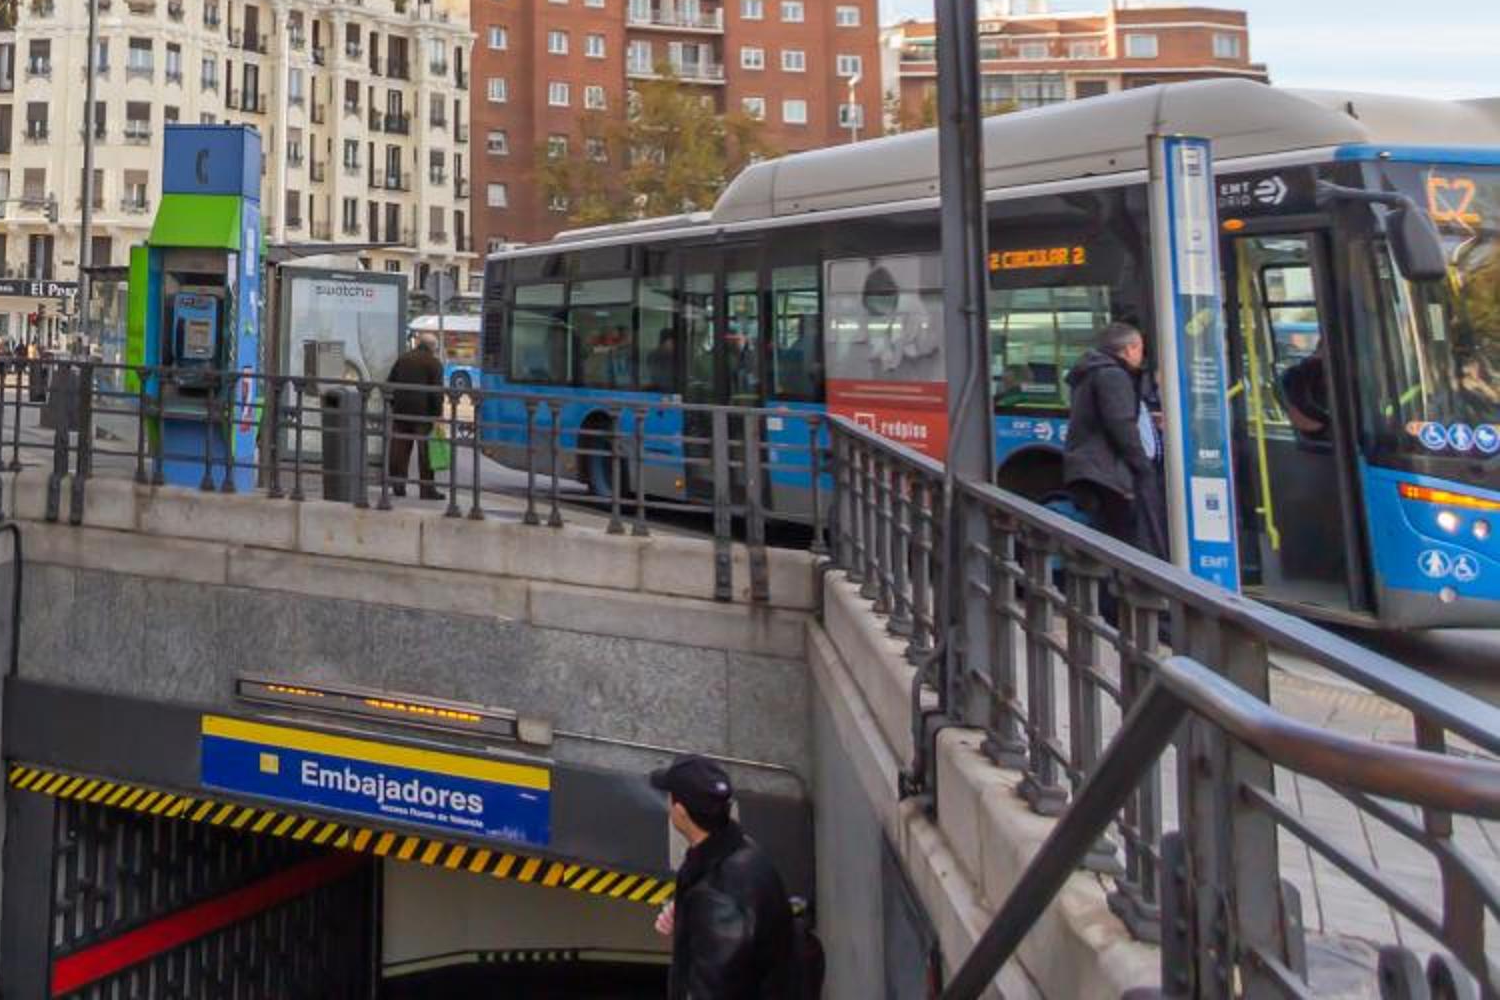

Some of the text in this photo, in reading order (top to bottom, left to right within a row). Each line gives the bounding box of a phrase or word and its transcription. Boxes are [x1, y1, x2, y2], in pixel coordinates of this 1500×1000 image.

[1220, 182, 1250, 195] EMT
[1427, 176, 1482, 222] C2
[1073, 246, 1086, 265] 2
[1201, 556, 1228, 568] EMT
[301, 760, 484, 814] Embajadores
